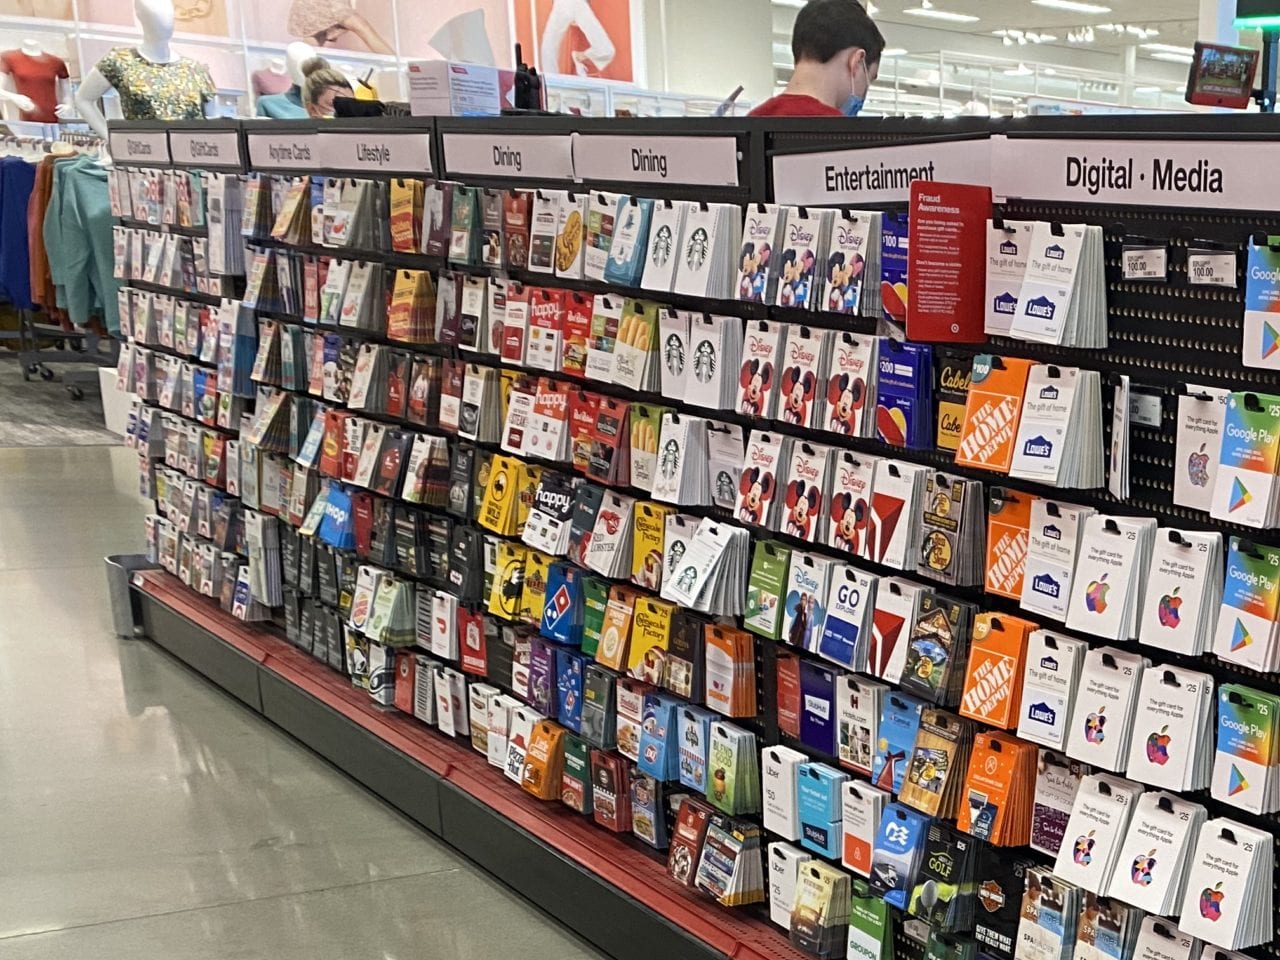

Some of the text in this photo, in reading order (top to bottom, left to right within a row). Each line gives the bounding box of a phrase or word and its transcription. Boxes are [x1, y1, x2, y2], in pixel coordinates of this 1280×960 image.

[356, 143, 390, 165] Lifestyle
[492, 145, 522, 173] Dining
[632, 147, 668, 177] Dining
[824, 160, 935, 192] Entertainment
[1065, 156, 1223, 195] Digital Media
[918, 193, 941, 202] Fraud
[918, 203, 960, 213] Awareness
[1193, 267, 1214, 277] 100.00
[838, 584, 860, 608] GO
